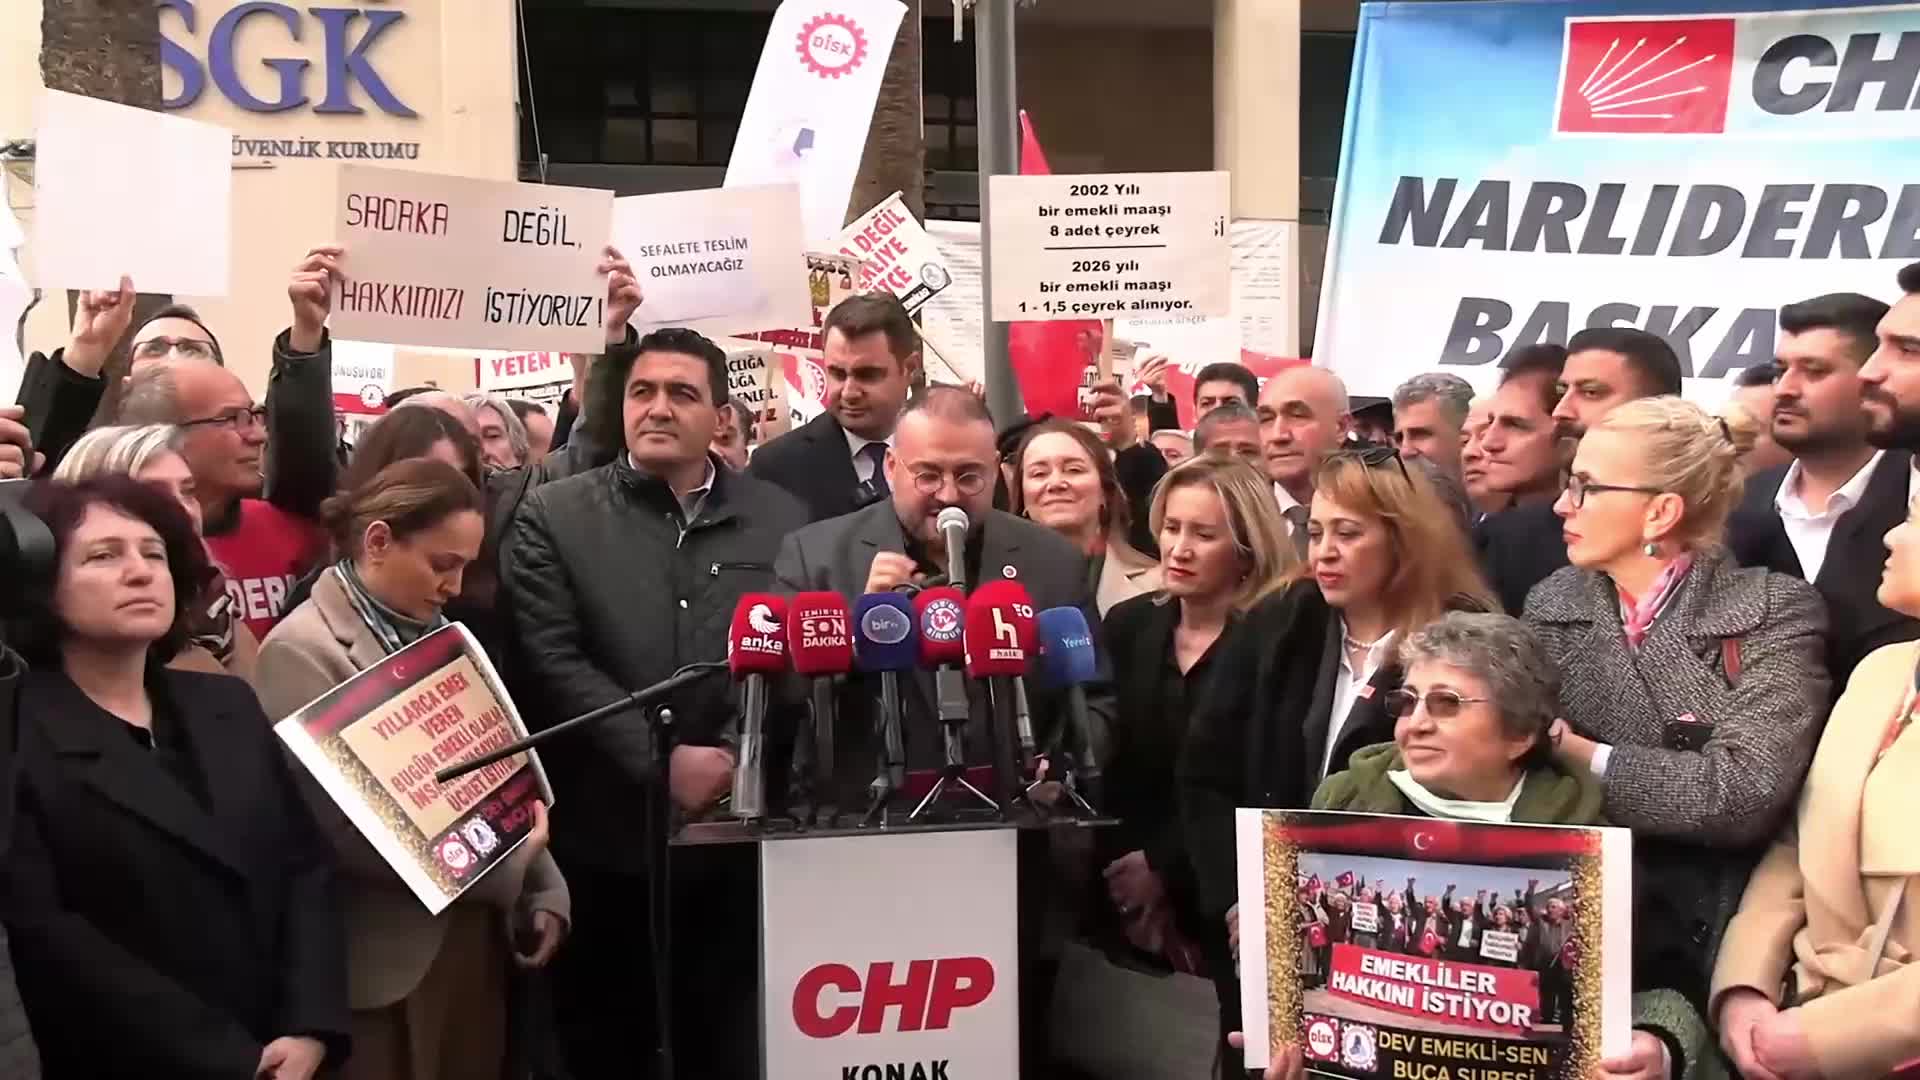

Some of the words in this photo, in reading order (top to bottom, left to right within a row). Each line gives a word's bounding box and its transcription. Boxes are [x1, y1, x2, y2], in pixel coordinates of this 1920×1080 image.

[158, 0, 418, 118] SGK
[1752, 32, 1920, 115] CH
[232, 135, 322, 158] ÜVENLİK
[327, 139, 420, 160] KURUMU
[1070, 184, 1109, 196] 2002
[1114, 183, 1140, 196] Yılı
[1039, 205, 1061, 217] bir
[1065, 204, 1118, 216] emekli
[1123, 203, 1171, 217] maaşı
[346, 193, 449, 236] SADAKA
[503, 206, 582, 251] DEĞİL,
[853, 208, 907, 253] DEĞİL
[1050, 225, 1059, 237] 8
[1064, 224, 1100, 237] adet
[1105, 223, 1160, 239] çeyrek
[640, 241, 701, 257] SEFALETE
[704, 235, 748, 252] TESLİM
[650, 256, 744, 278] OLMAYACAĞIZ
[1072, 260, 1111, 273] 2026
[1115, 260, 1140, 275] yılı
[1040, 281, 1061, 293] bir
[1066, 280, 1119, 293] emekli
[1123, 279, 1171, 293] maaşı
[340, 279, 464, 321] HAKKIMIZI
[1019, 301, 1027, 314] 1
[1043, 300, 1067, 315] 1,5
[1072, 299, 1126, 316] çeyrek
[1131, 297, 1192, 313] alınıyor.
[492, 352, 550, 376] YETEN
[729, 355, 765, 373] CLIĞA
[741, 634, 783, 651] anka
[1360, 953, 1497, 996] EMEKLİLER
[792, 957, 995, 1038] CHP
[1332, 971, 1415, 1008] HAKKINI
[1422, 985, 1532, 1028] İSTİYOR
[1379, 1031, 1416, 1053] DEV
[1421, 1040, 1548, 1064] EMEKLİ-SEN
[842, 1060, 949, 1080] KONAK
[1394, 1059, 1450, 1080] BUCA
